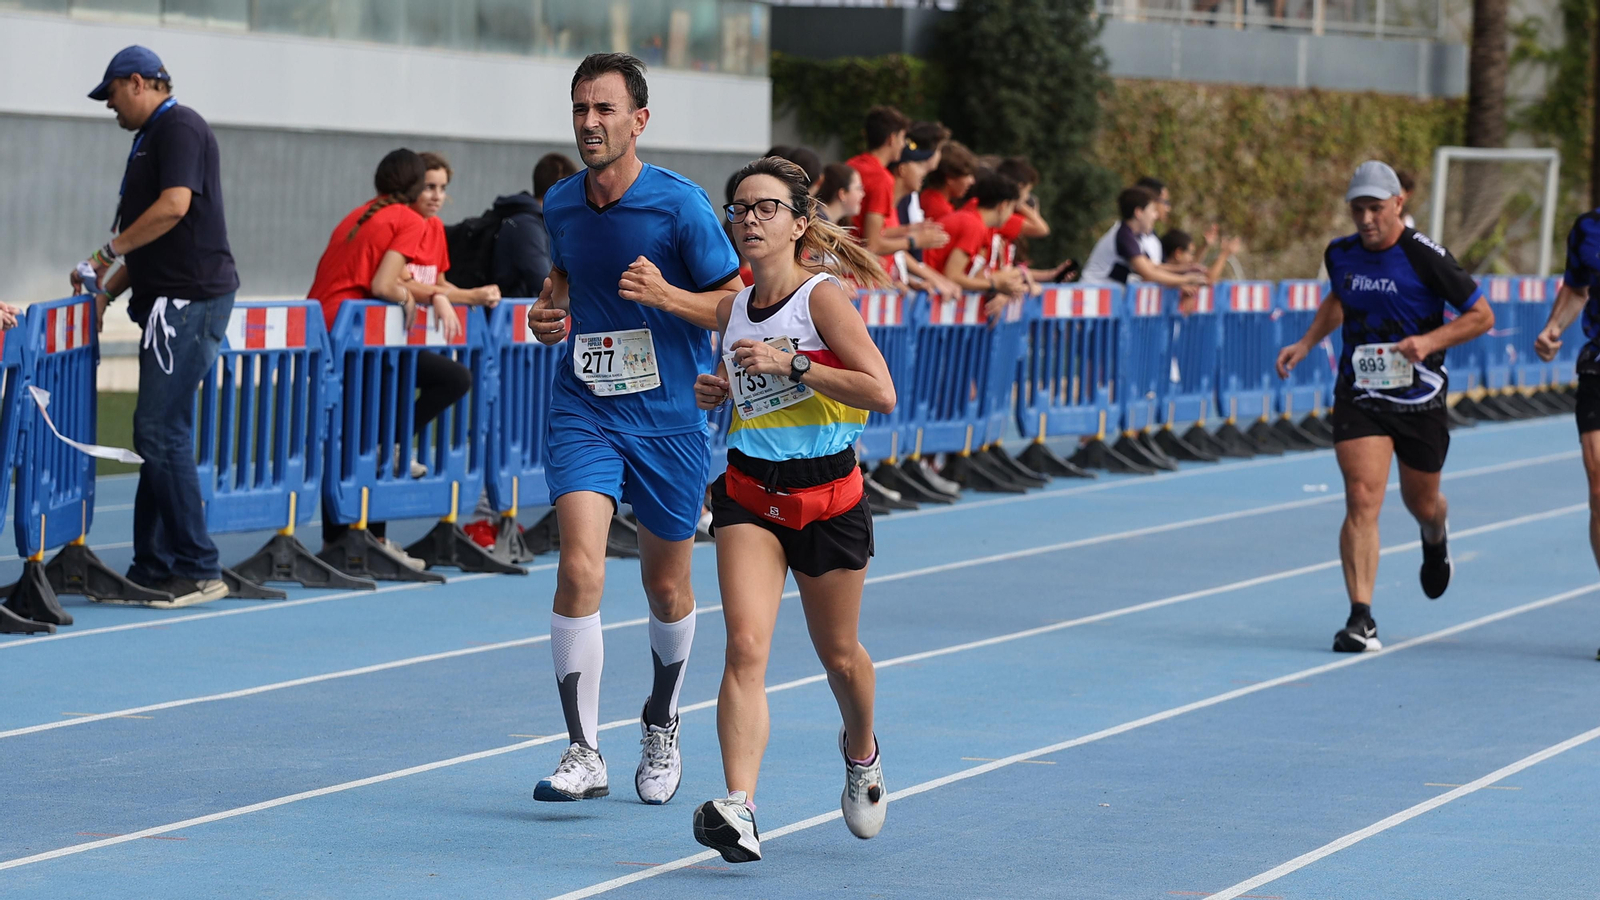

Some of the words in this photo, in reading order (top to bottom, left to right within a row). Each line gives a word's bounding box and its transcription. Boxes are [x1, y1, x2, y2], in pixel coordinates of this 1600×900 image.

[1351, 278, 1398, 294] PIRATA
[582, 350, 614, 373] 277
[1359, 357, 1386, 372] 893
[735, 369, 767, 395] 733
